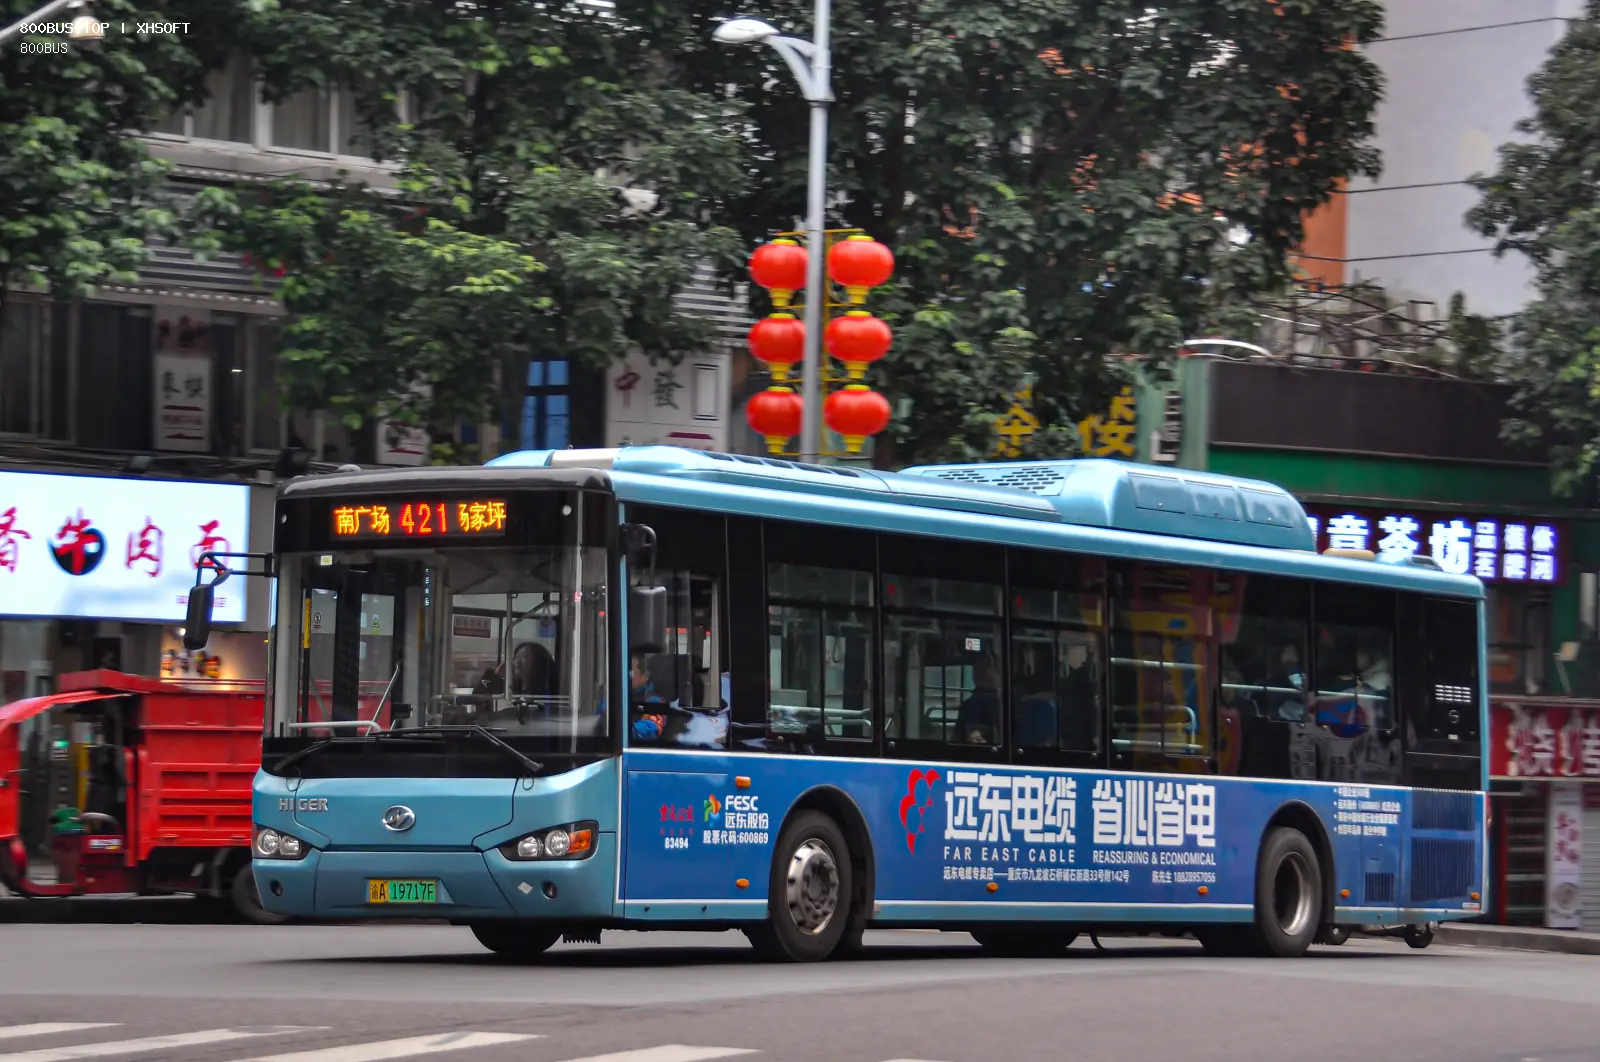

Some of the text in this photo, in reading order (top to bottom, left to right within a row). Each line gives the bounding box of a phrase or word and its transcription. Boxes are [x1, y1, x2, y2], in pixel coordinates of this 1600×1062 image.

[333, 505, 391, 535] 南广场
[400, 502, 449, 534] 421
[1306, 514, 1473, 575] 音茶坊
[279, 798, 329, 812] HIGER
[725, 795, 759, 811] FESC
[944, 770, 1217, 847] 远东电缆 省心省电
[724, 812, 769, 830] 远东股份
[664, 837, 689, 849] 83494
[943, 846, 1217, 866] FAR EAST CABLE REASSURING & ECONOMICAL
[371, 883, 435, 900] 渝A 19717F
